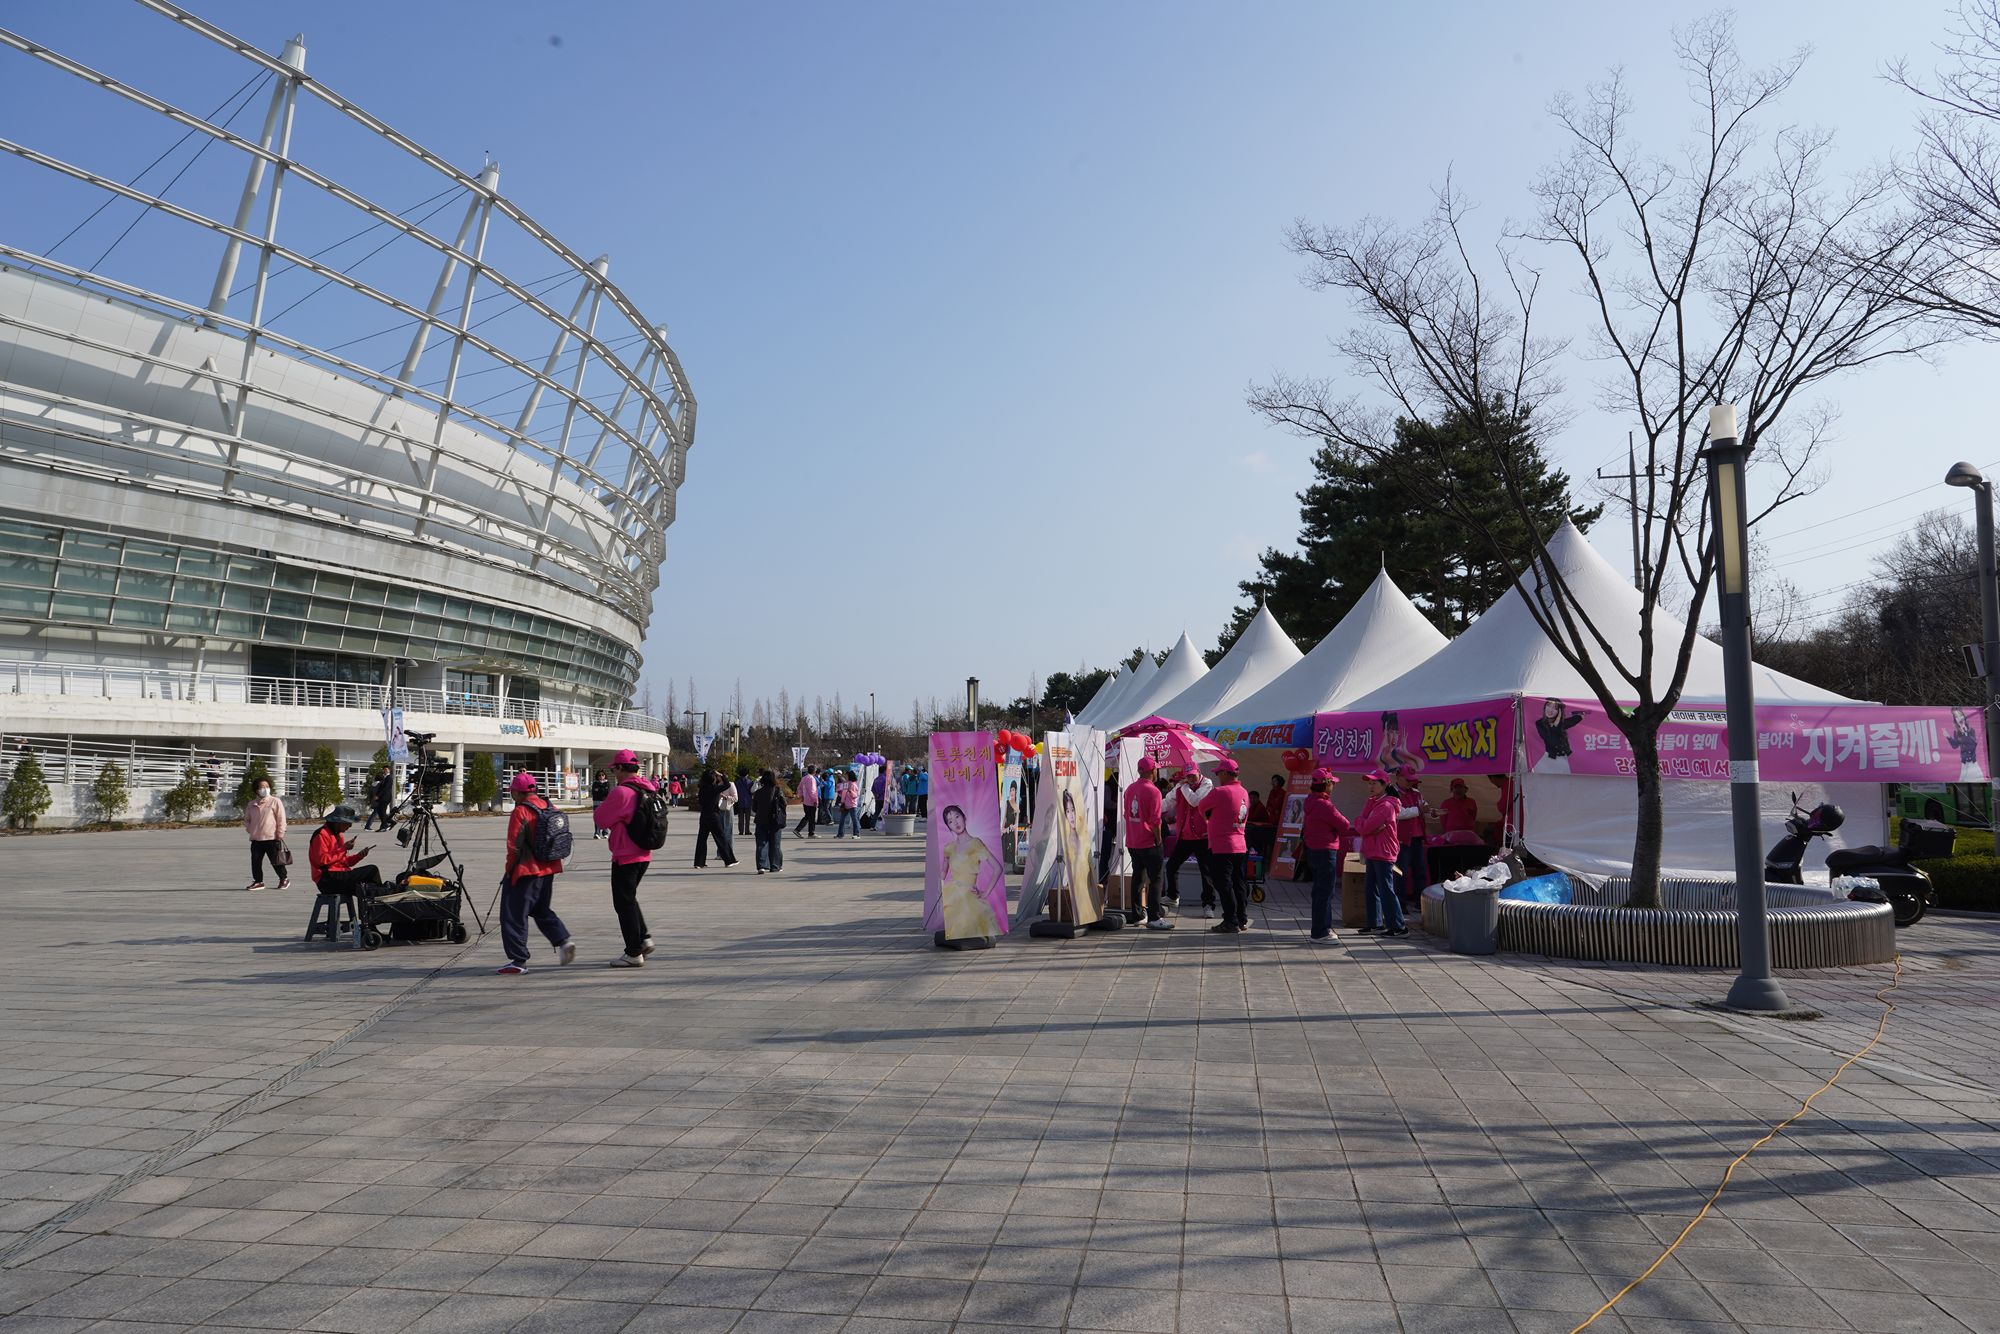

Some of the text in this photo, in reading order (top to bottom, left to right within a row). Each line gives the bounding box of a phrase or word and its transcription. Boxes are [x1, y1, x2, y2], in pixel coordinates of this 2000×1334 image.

[1671, 711, 1696, 721] 네이버
[1316, 726, 1373, 760] 감성천재
[1421, 717, 1497, 762] 빈예서
[1584, 734, 1622, 751] 앞으로
[1692, 733, 1718, 751] 옆에
[1758, 731, 1795, 750] 붙어서
[1801, 718, 1941, 773] 지켜줄께!
[943, 765, 986, 783] 빈예서
